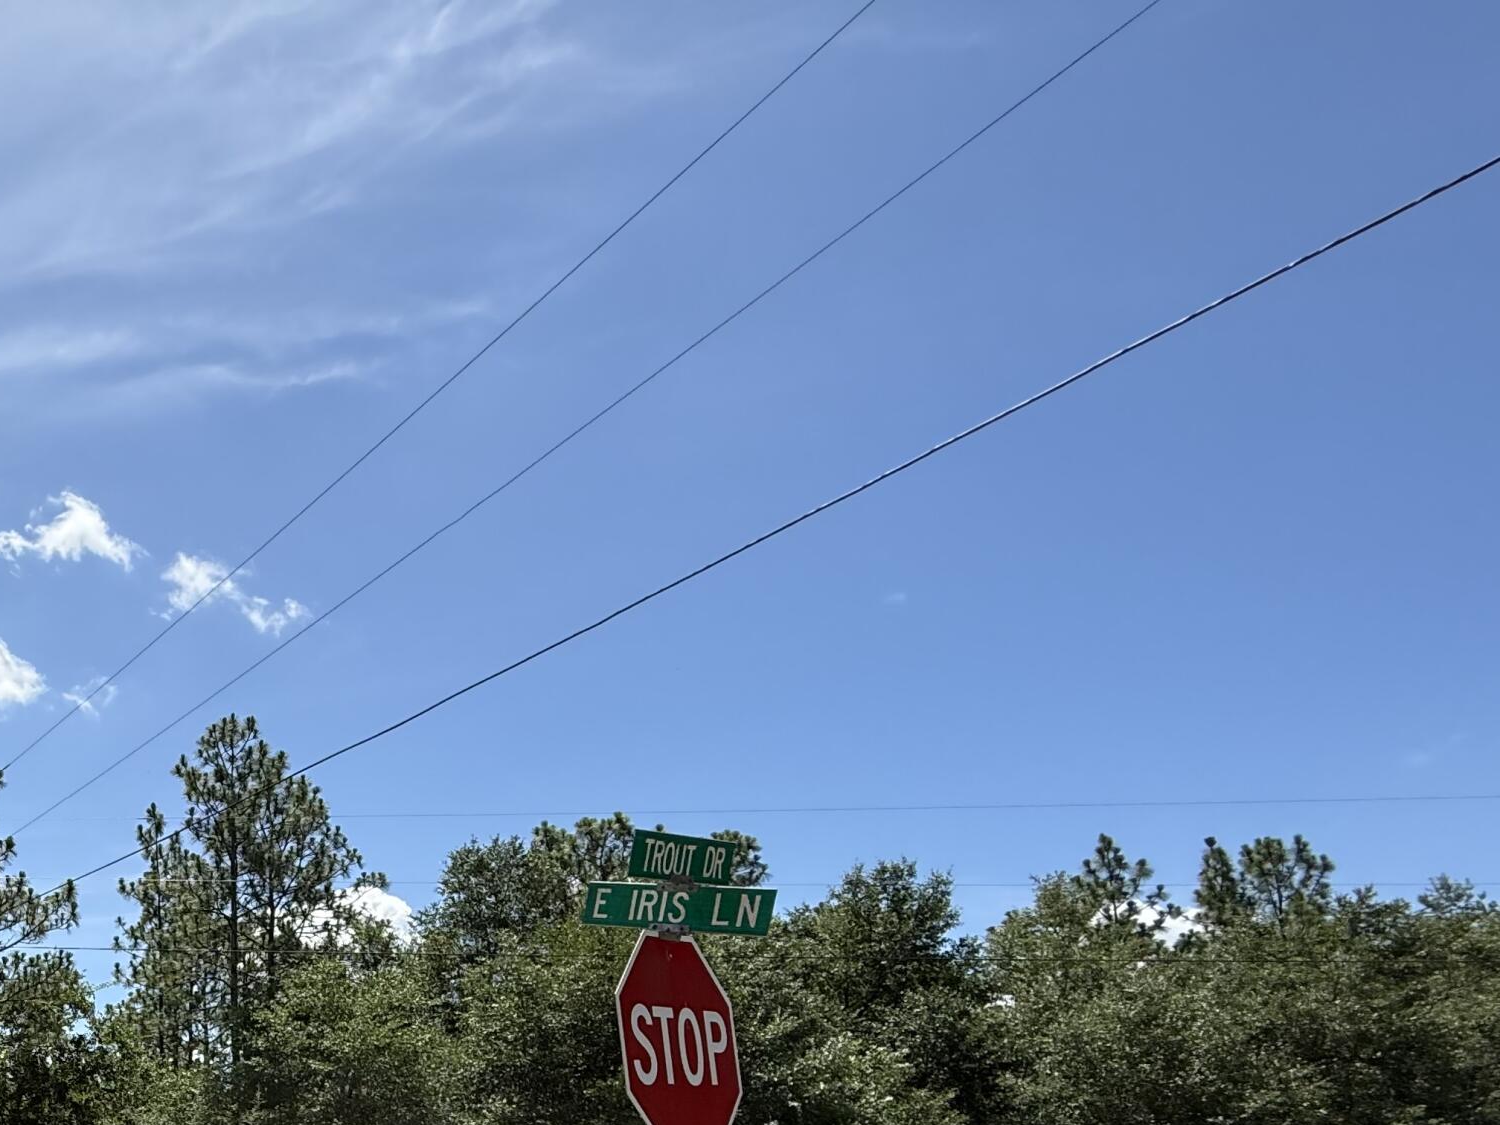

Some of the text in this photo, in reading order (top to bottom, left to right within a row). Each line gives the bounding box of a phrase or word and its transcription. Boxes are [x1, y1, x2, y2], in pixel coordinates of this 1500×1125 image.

[643, 838, 726, 879] TROUT DR
[592, 888, 762, 928] E IRIS LN
[631, 1003, 727, 1086] STOP
